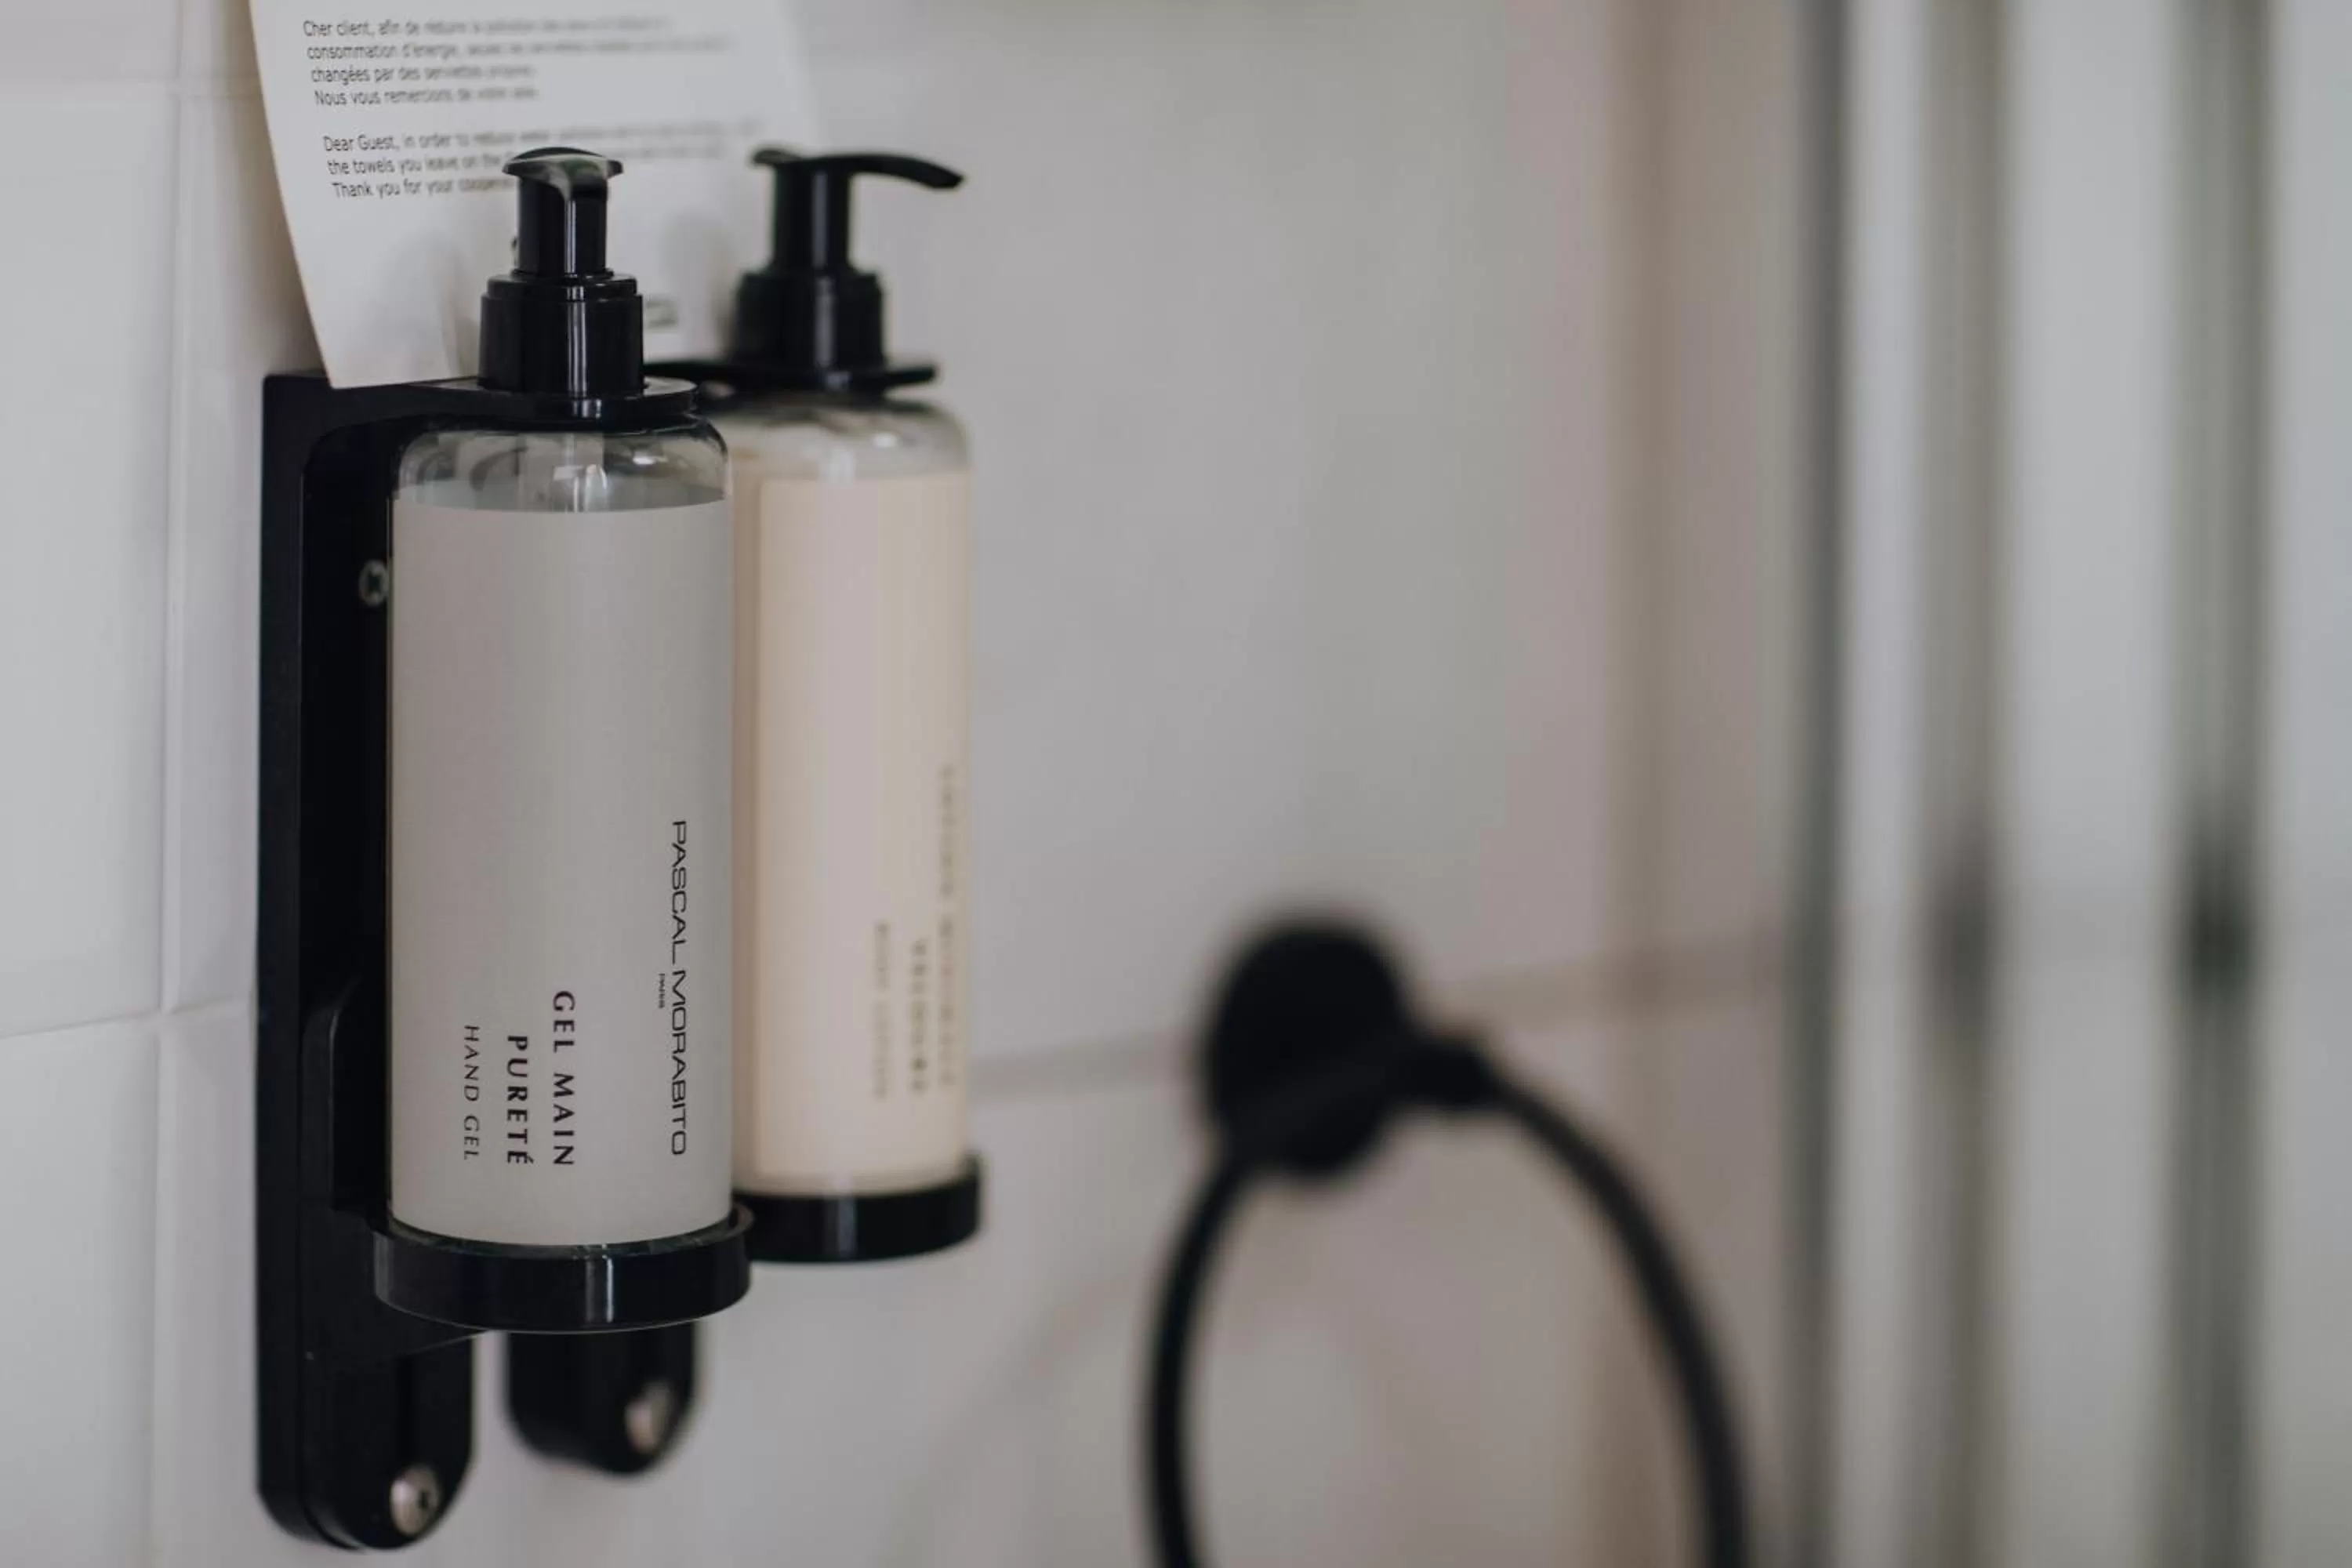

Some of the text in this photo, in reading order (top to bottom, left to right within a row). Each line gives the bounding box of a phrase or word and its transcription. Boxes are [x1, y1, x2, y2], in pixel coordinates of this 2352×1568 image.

[303, 20, 332, 38] Cher
[336, 20, 375, 37] client,
[379, 19, 400, 36] afin
[307, 43, 397, 60] consommation
[310, 64, 371, 85] changées
[373, 67, 394, 83] par
[314, 90, 347, 106] Nous
[351, 90, 382, 105] vous
[322, 135, 354, 152] Dear
[357, 133, 400, 152] Guest,
[403, 134, 416, 148] in
[418, 133, 451, 149] order
[327, 158, 350, 175] the
[352, 156, 396, 175] towels
[397, 159, 423, 176] you
[331, 180, 374, 198] Thank
[376, 182, 401, 199] you
[403, 178, 422, 195] for
[670, 820, 688, 1156] PASCAL MORABITO
[553, 990, 575, 1166] GEL MAIN
[464, 1025, 481, 1160] HAND GEL
[506, 1035, 535, 1165] PURETÉ
